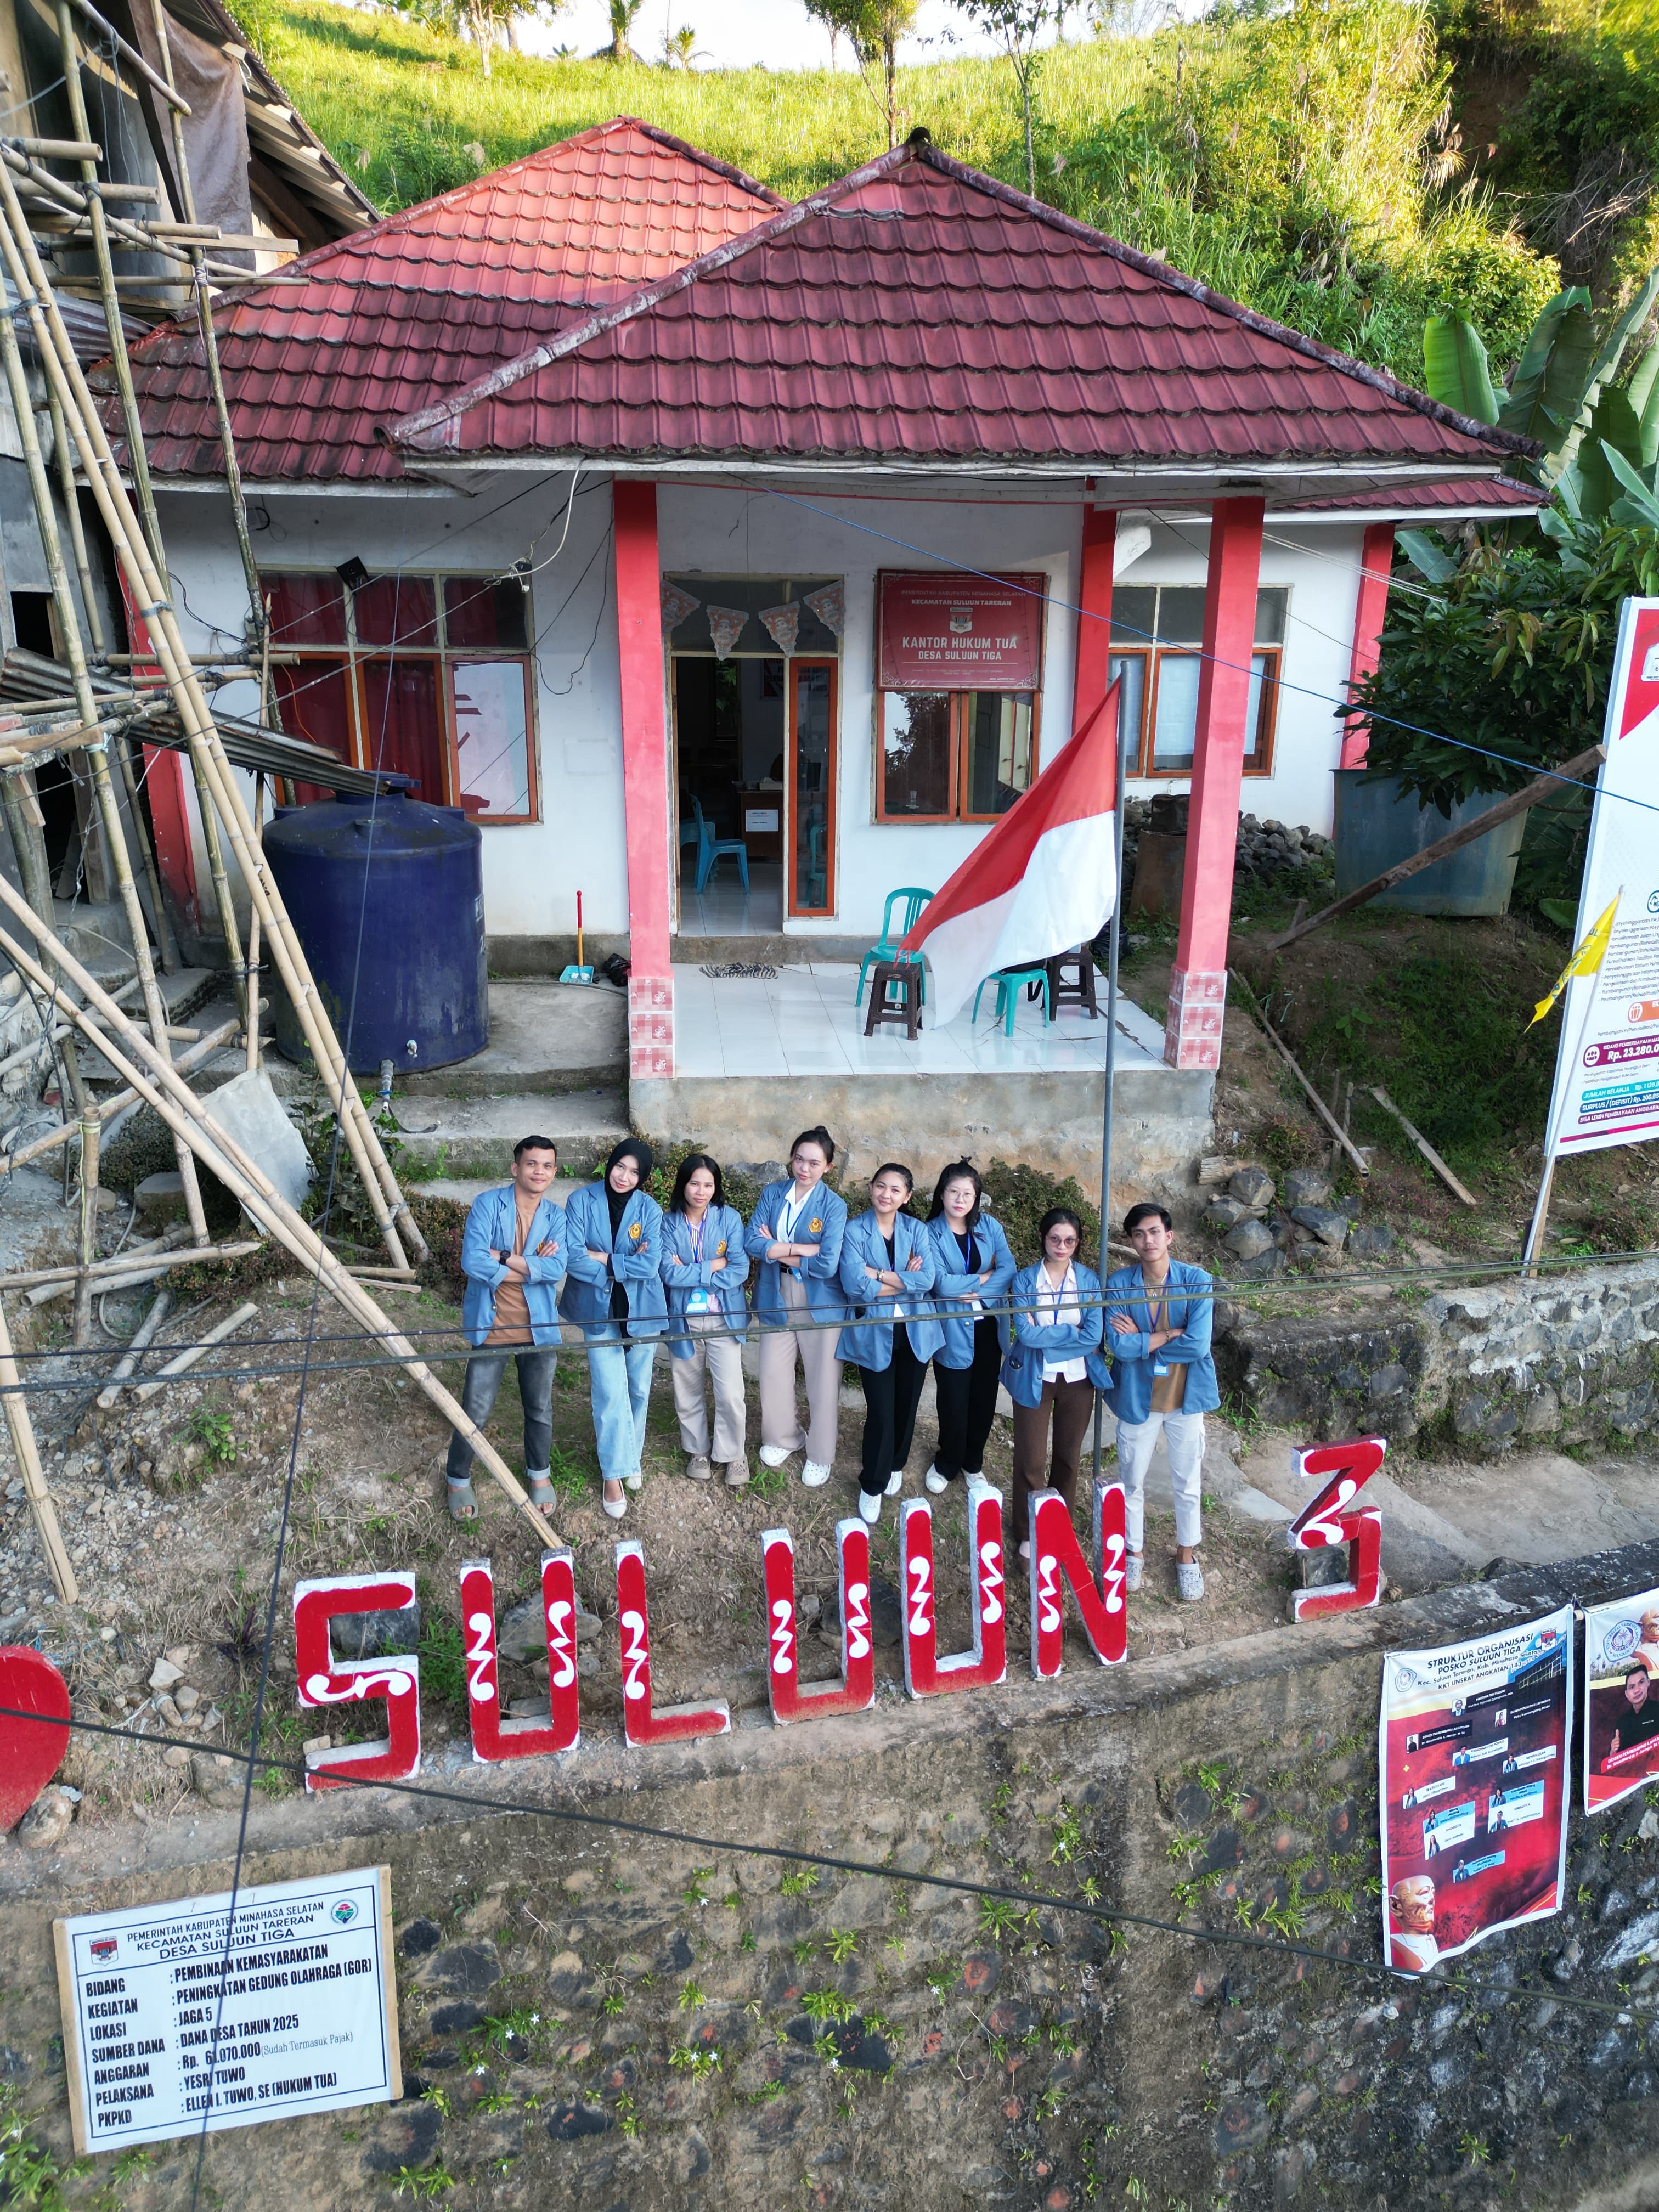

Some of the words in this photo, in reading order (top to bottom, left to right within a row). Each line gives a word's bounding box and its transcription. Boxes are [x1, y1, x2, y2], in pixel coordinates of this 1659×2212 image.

[902, 636, 948, 648] KANTOR
[952, 637, 991, 649] HUKUM
[996, 637, 1017, 650] TUA
[918, 651, 941, 659] DESA
[945, 651, 979, 660] SULUUN
[981, 651, 1001, 660] TIGA
[1607, 1051, 1622, 1063] Rp.
[1582, 1102, 1606, 1111] SURPLUS
[1584, 1090, 1606, 1099] JUMLAH
[1606, 1086, 1630, 1094] BELANJA
[293, 1477, 1128, 1793] SULUUN
[1287, 1434, 1387, 1624] 3
[1427, 1649, 1474, 1669] STRUKTUR
[1477, 1633, 1533, 1655] ORGANISASI
[1433, 1675, 1452, 1684] Suluun
[1491, 1655, 1519, 1666] Minahasa
[1520, 1649, 1542, 1658] Selatan
[1438, 1660, 1466, 1674] POSKO
[1469, 1651, 1501, 1665] SULUUN
[1503, 1645, 1521, 1657] TIGA
[1451, 1675, 1475, 1688] UNSRAT
[1476, 1665, 1509, 1679] ANGKATAN
[127, 1925, 183, 1942] PEMERINTAH
[185, 1916, 236, 1932] KABUPATEN
[239, 1908, 284, 1923] MINAHASA
[286, 1901, 324, 1915] SELATAN
[137, 1931, 211, 1951] KECAMATAN
[262, 1915, 314, 1929] TARERAN
[160, 1944, 198, 1959] DESA
[201, 1934, 256, 1952] SULUUN
[261, 1928, 295, 1942] TIGA
[86, 1977, 126, 1997] BIDANG
[174, 1959, 234, 1983] PEMBINAAN
[236, 1943, 329, 1973] KEMASYARAKATAN
[87, 1997, 138, 2019] KEGIATAN
[176, 1979, 246, 2005] PENINGKATAN
[248, 1972, 289, 1993] GEDUNG
[290, 1963, 342, 1985] OLAHRAGA
[343, 1958, 372, 1976] (GOR)
[89, 2021, 127, 2041] LOKASI
[179, 2008, 204, 2027] JAGA
[205, 2006, 213, 2022] 5
[91, 2042, 136, 2063] SUMBER
[137, 2038, 166, 2056] DANA
[180, 2029, 208, 2048] DANA
[210, 2024, 236, 2043] DESA
[237, 2018, 271, 2038] TAHUN
[272, 2013, 300, 2032] 2025
[94, 2062, 150, 2085] ANGGARAN
[182, 2055, 199, 2070] Rp.
[261, 2041, 288, 2058] (Sudah
[289, 2036, 328, 2051] Termasuk
[329, 2031, 354, 2045] Pajak)
[95, 2083, 154, 2107] PELAKSANA
[183, 2072, 213, 2091] YESRI
[215, 2066, 246, 2086] TUWO
[98, 2109, 132, 2128] PKPKD
[185, 2093, 213, 2112] ELLEN
[223, 2086, 257, 2106] TUWO,
[258, 2083, 270, 2100] SE
[272, 2076, 313, 2097] (HUKUM
[314, 2072, 337, 2090] TUA)
